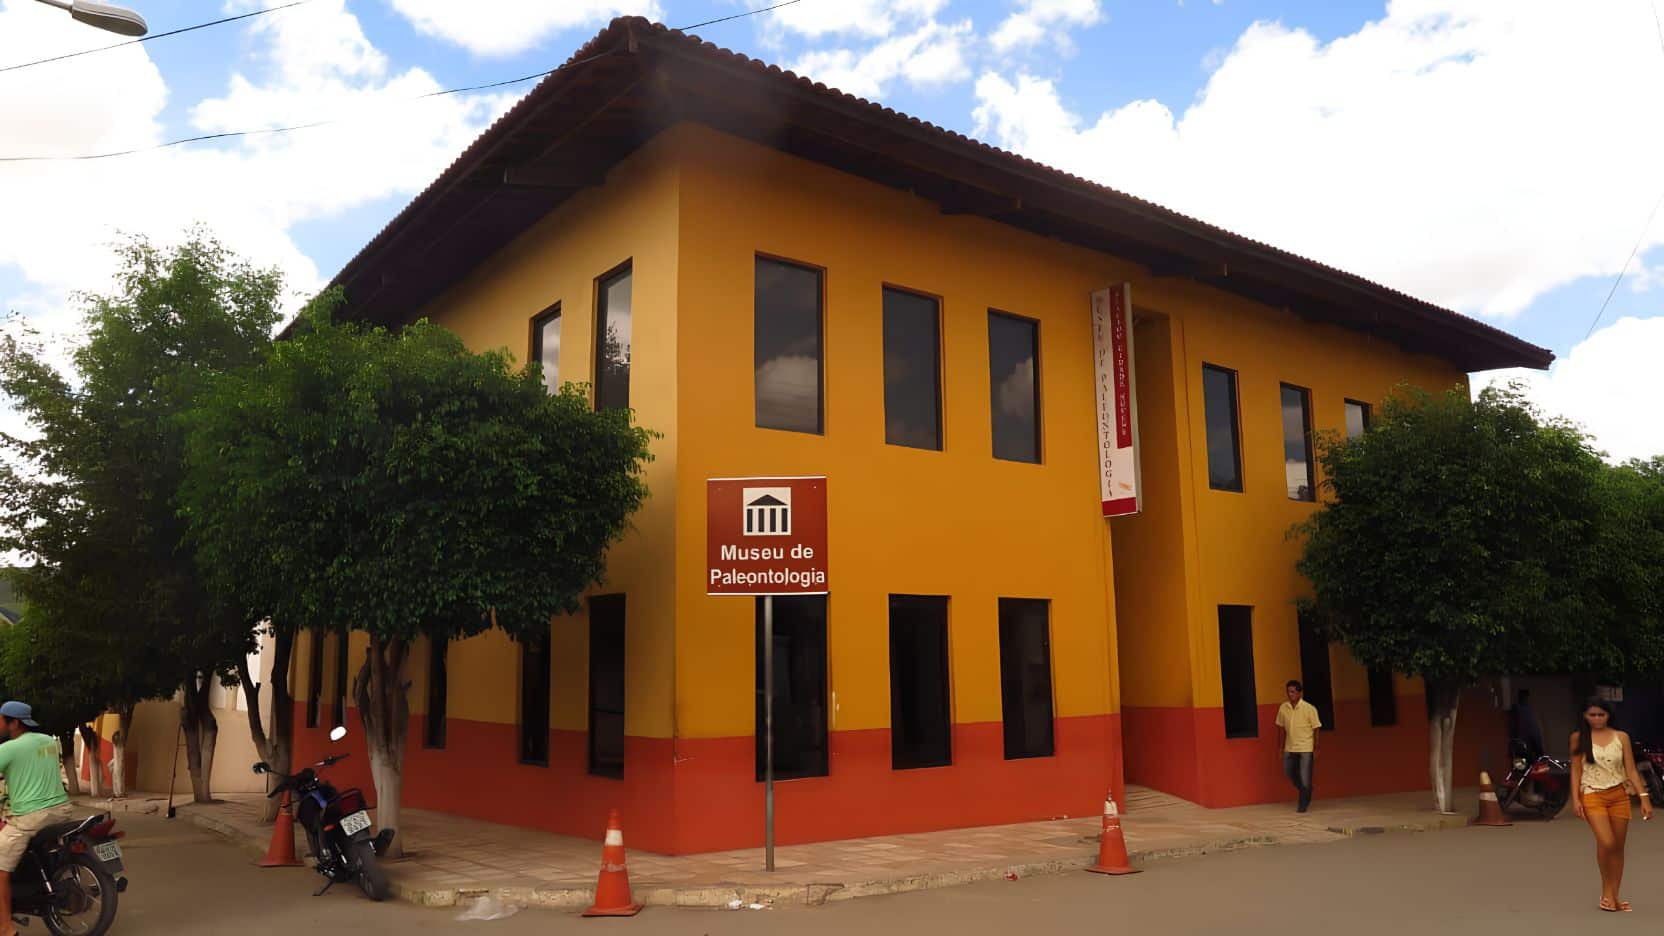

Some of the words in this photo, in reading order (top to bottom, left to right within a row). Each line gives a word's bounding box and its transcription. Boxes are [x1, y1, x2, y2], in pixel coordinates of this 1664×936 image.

[721, 544, 784, 561] Museu
[790, 543, 814, 559] de
[710, 567, 825, 588] Paleontologia
